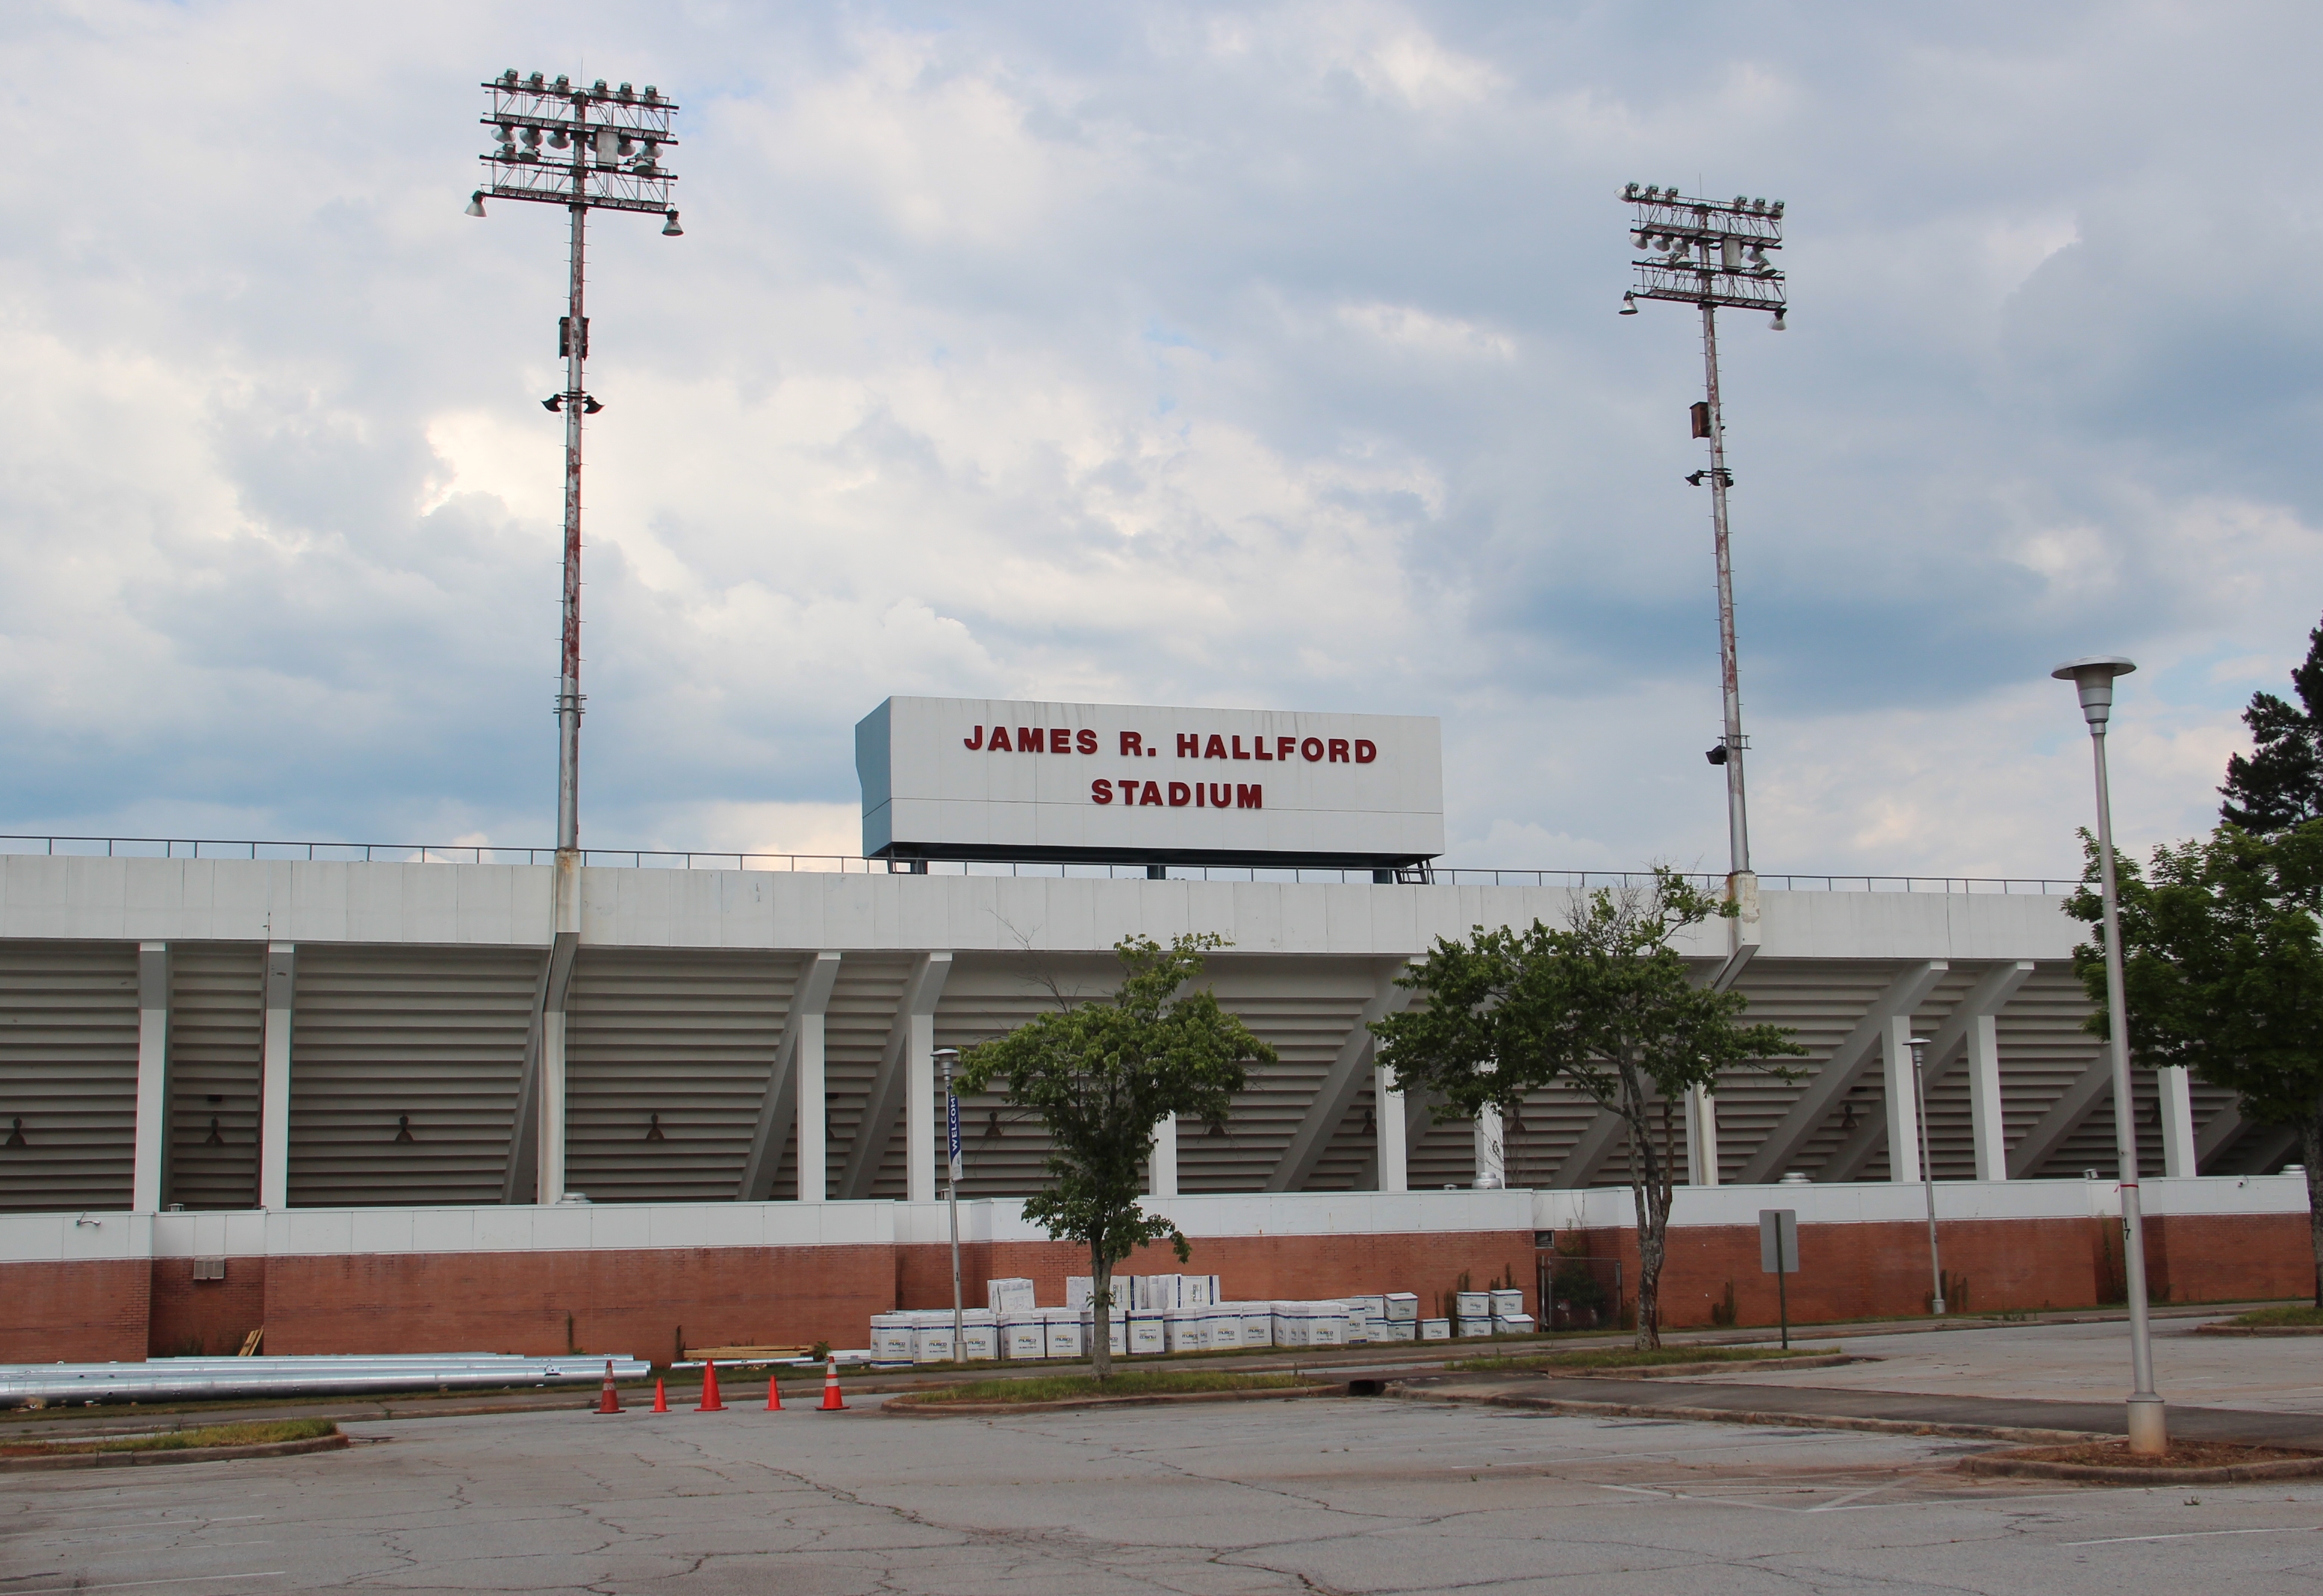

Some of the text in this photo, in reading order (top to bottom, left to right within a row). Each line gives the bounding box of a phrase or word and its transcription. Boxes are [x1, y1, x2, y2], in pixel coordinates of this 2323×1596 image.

[964, 725, 1377, 764] JAMES R. HALLFORD
[1092, 779, 1262, 808] STADIUM
